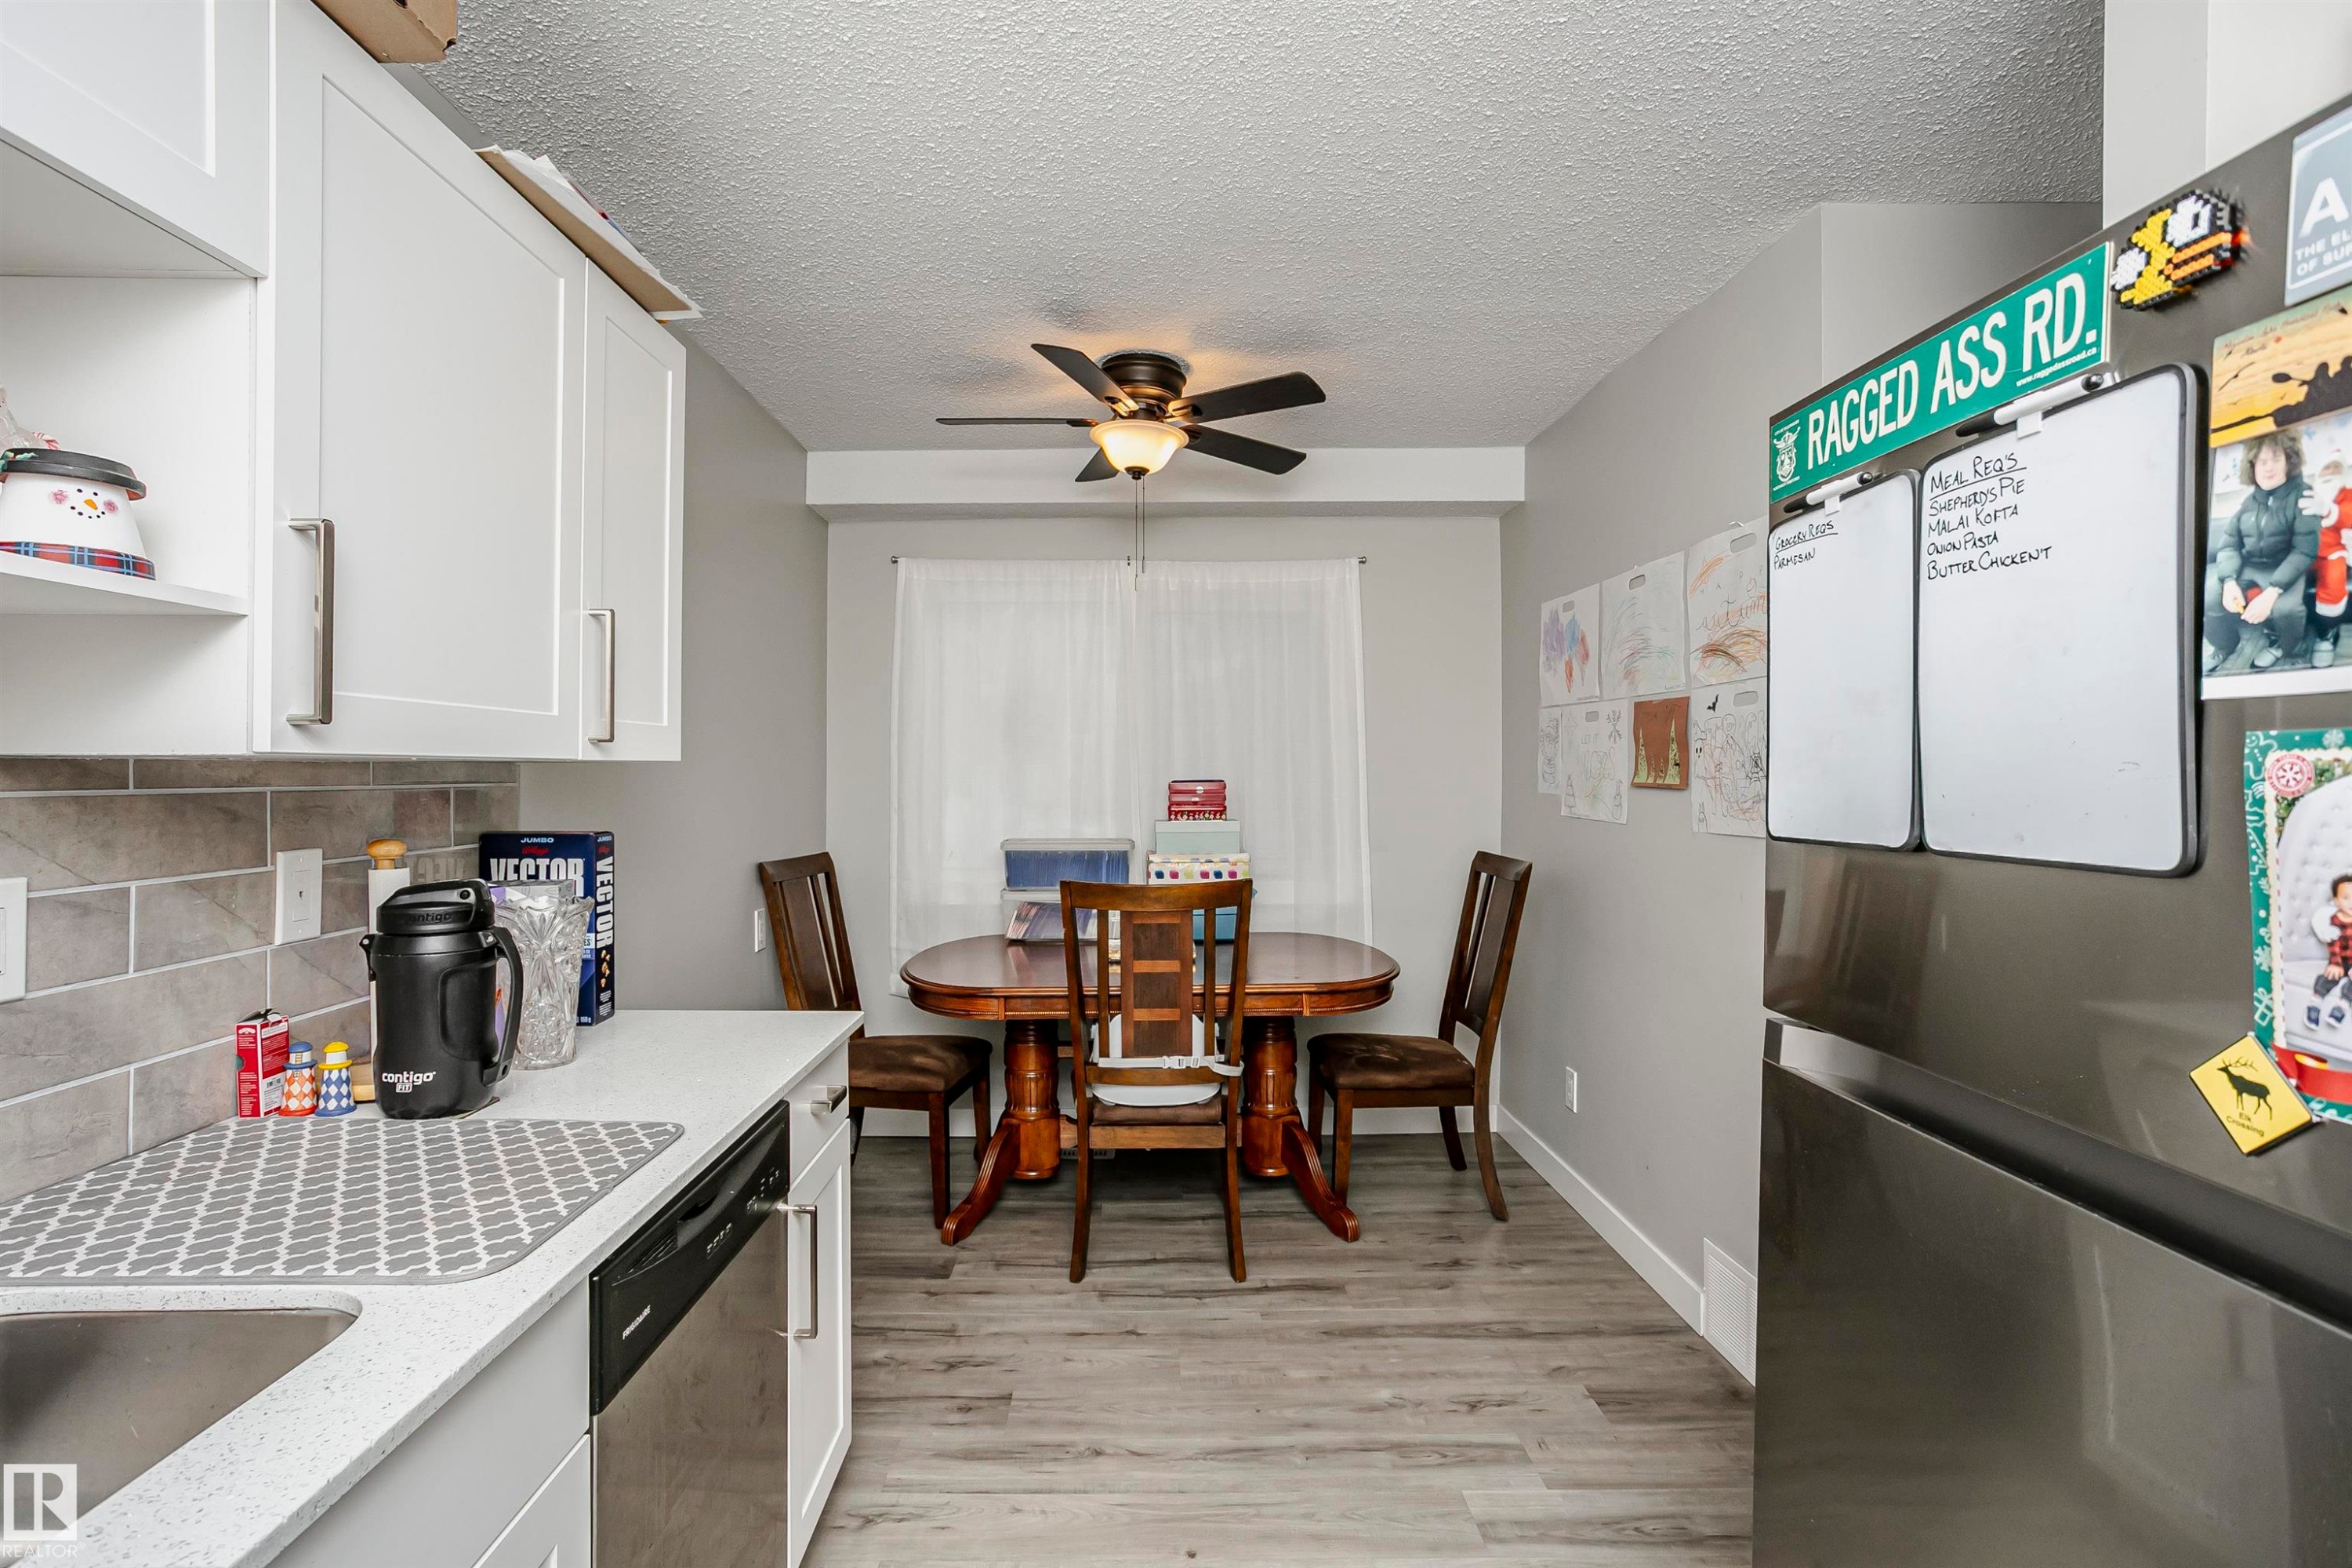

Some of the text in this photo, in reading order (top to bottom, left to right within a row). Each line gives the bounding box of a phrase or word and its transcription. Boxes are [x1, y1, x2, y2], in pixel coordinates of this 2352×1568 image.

[2295, 238, 2325, 261] THE
[2296, 257, 2318, 276] OF
[1807, 272, 2097, 470] RAGGED ASS RD.
[1929, 514, 1969, 538] MALAI
[1963, 531, 1998, 550] PASTA
[1774, 547, 1816, 571] PARMESAN
[1927, 560, 1977, 580] BUTTER
[490, 858, 585, 897] VECTOR
[597, 856, 613, 949] VECTOR
[382, 1071, 434, 1085] contigo
[2227, 1116, 2264, 1137] Crossing
[2239, 1112, 2252, 1122] Elk
[622, 1305, 651, 1340] FRIGIDAIRE
